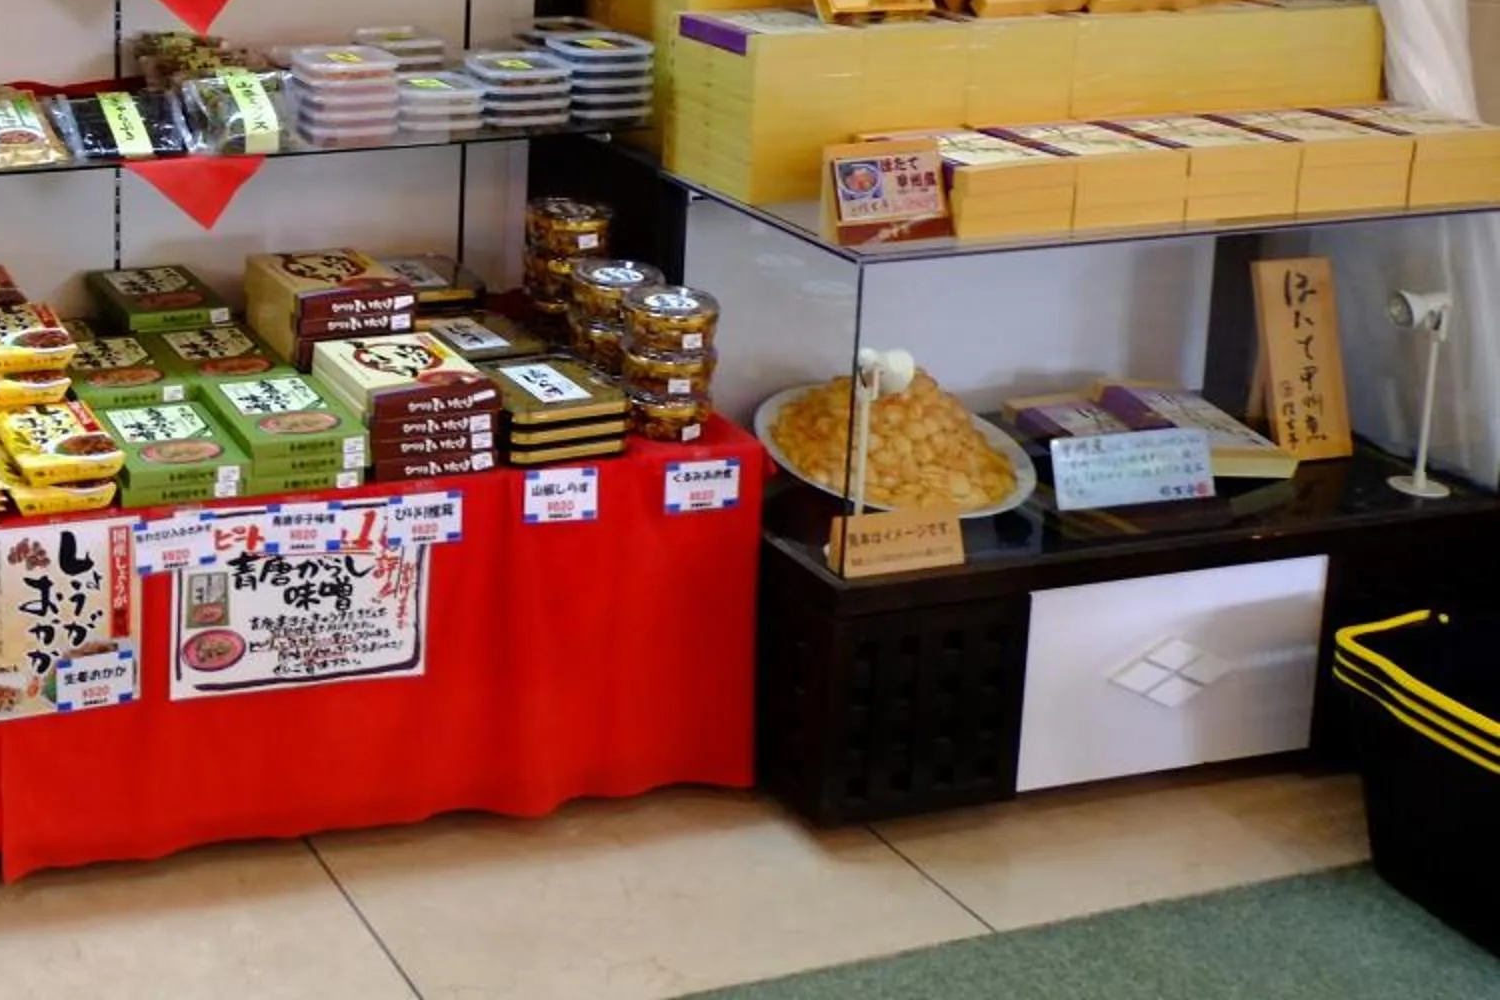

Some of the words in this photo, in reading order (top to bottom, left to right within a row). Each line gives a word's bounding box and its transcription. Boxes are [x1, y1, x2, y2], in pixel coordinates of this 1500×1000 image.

[59, 531, 103, 646] しょうが
[227, 551, 375, 592] 青唐がらし
[283, 580, 355, 612] 味噌
[17, 575, 61, 675] おかか
